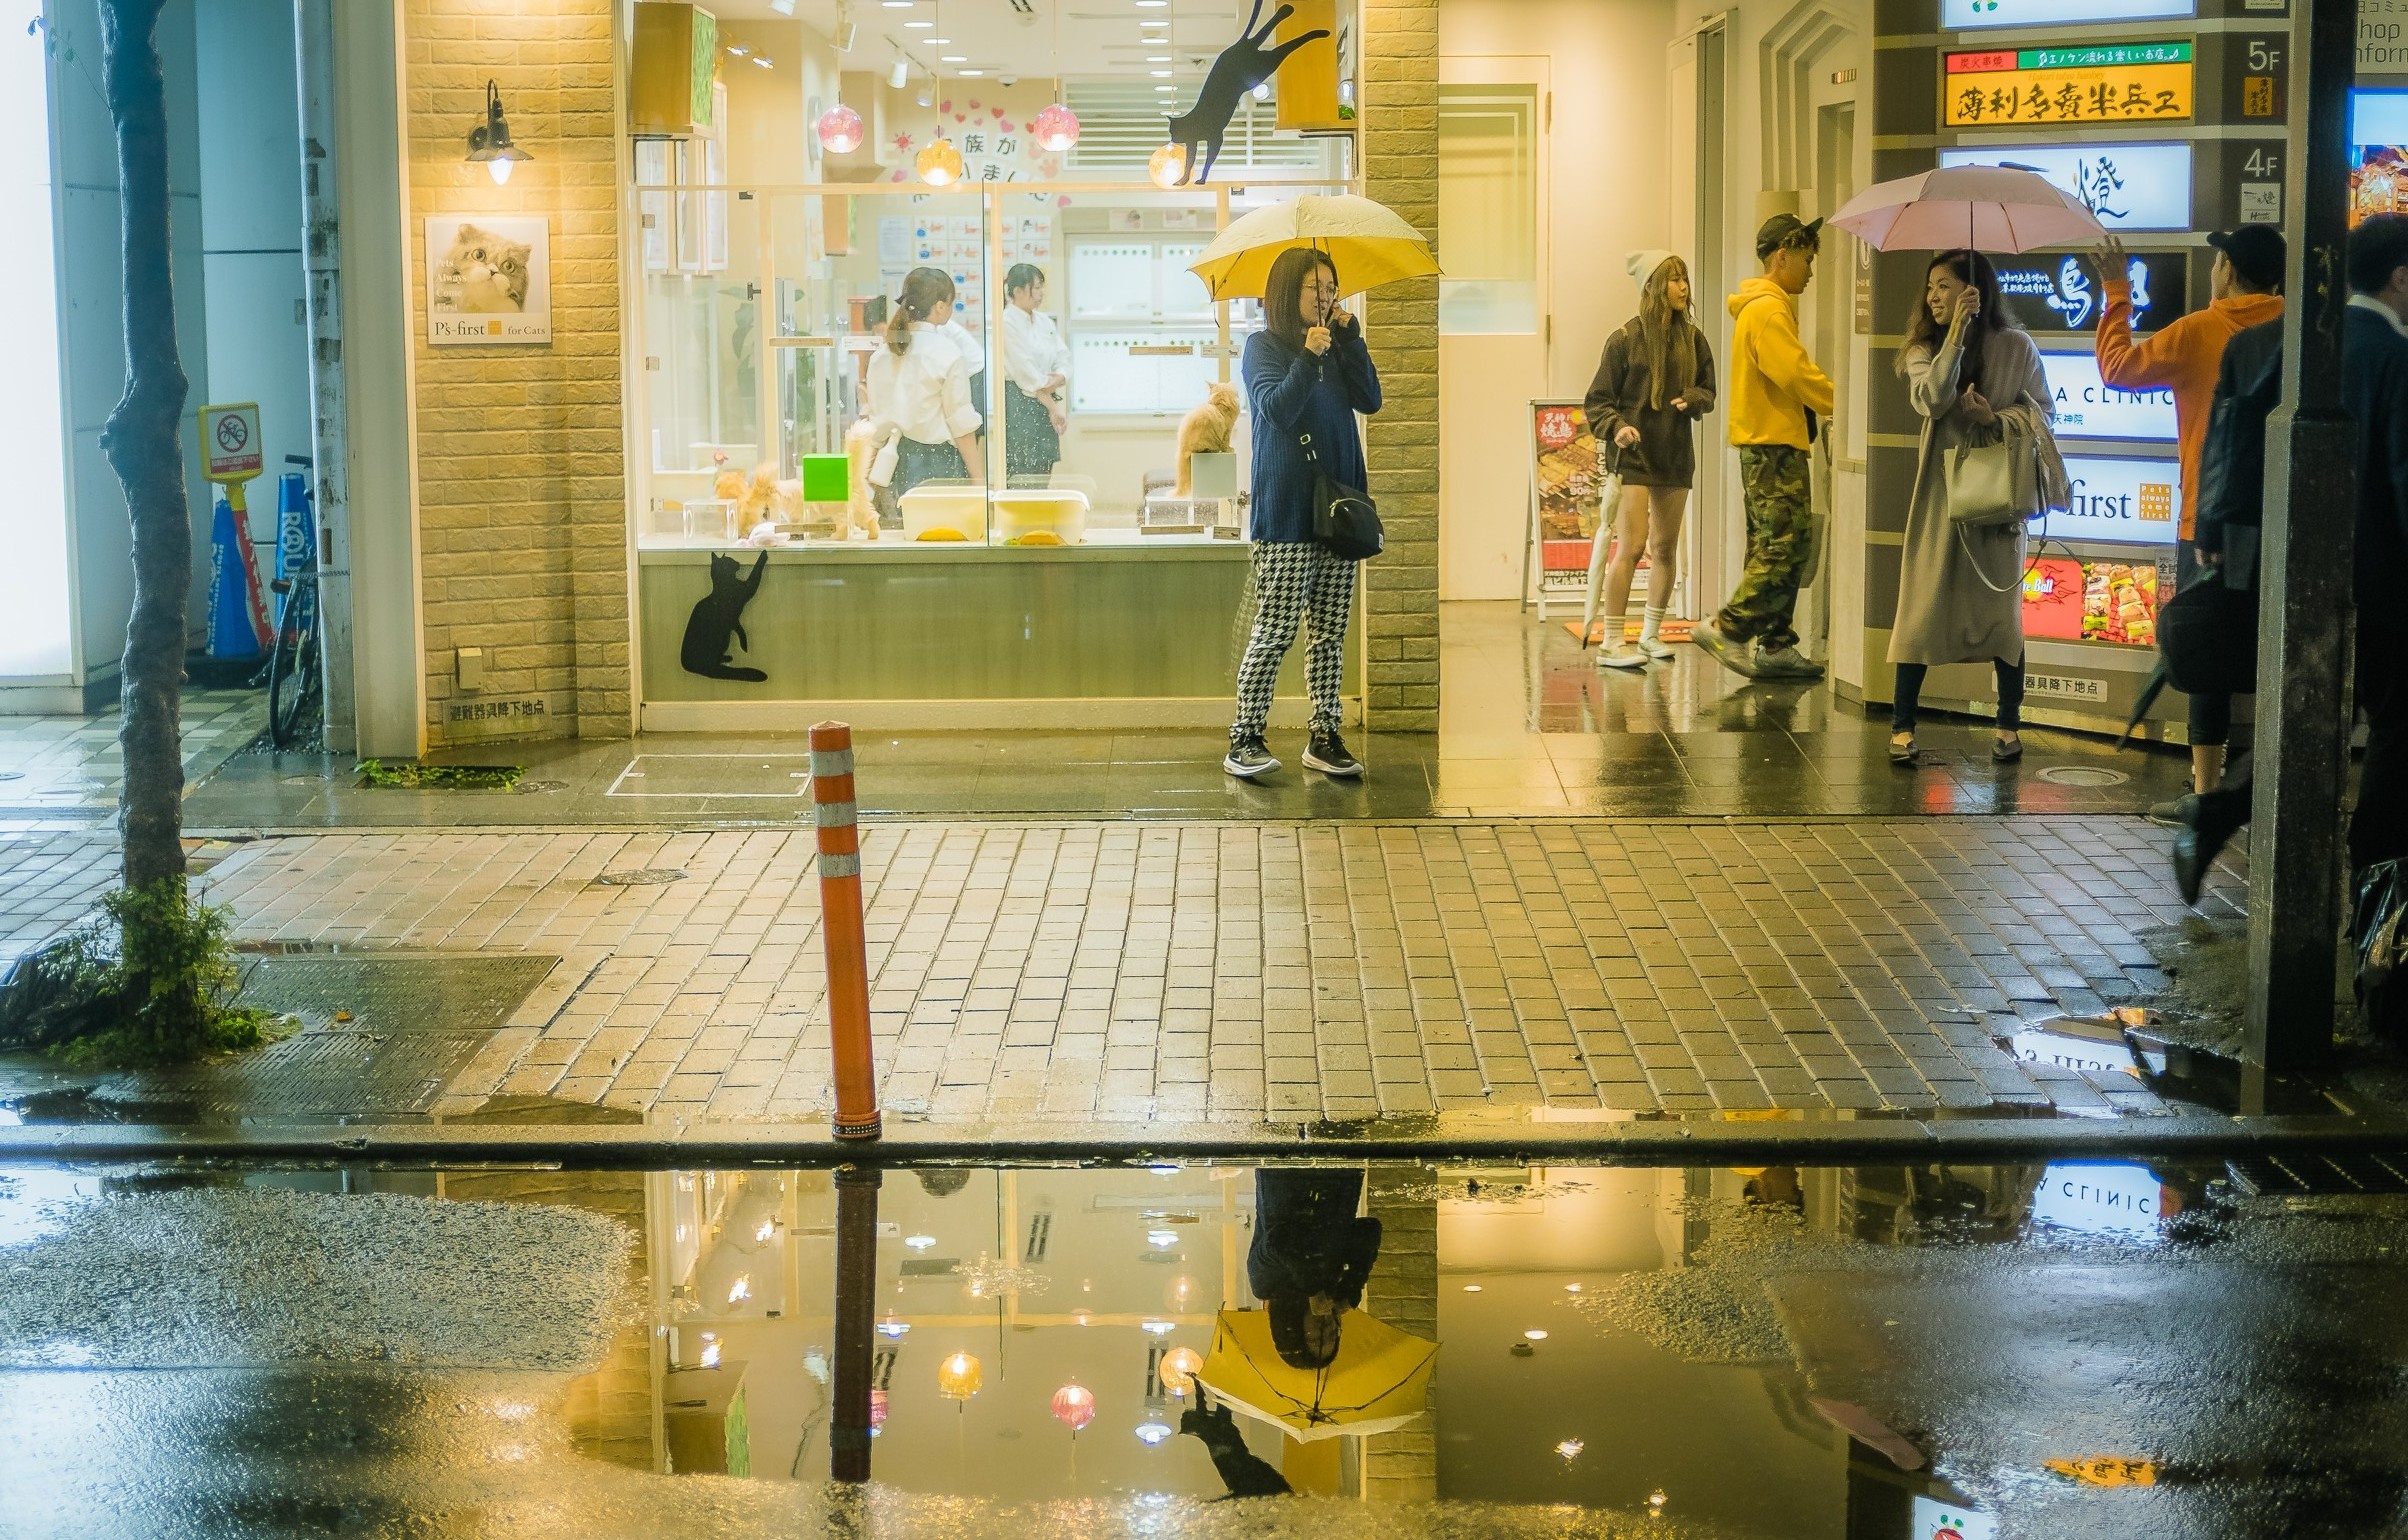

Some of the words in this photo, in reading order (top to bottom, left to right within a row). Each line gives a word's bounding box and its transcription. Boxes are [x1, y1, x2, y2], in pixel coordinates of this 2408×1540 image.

[2360, 18, 2400, 43] hop
[2248, 41, 2280, 71] 5F
[2243, 148, 2278, 178] 4F
[436, 259, 454, 267] Pets
[436, 273, 467, 284] Always
[436, 303, 458, 312] First
[508, 326, 521, 335] for
[524, 326, 546, 335] Cats
[2084, 387, 2173, 405] CLINIC
[2141, 485, 2170, 493] Pets
[2141, 494, 2170, 503] always
[2141, 503, 2169, 511] come
[2141, 510, 2169, 519] first
[2034, 578, 2053, 593] Ball
[2025, 676, 2098, 695] 器具降下地点
[450, 700, 545, 721] 避難器具降下地点
